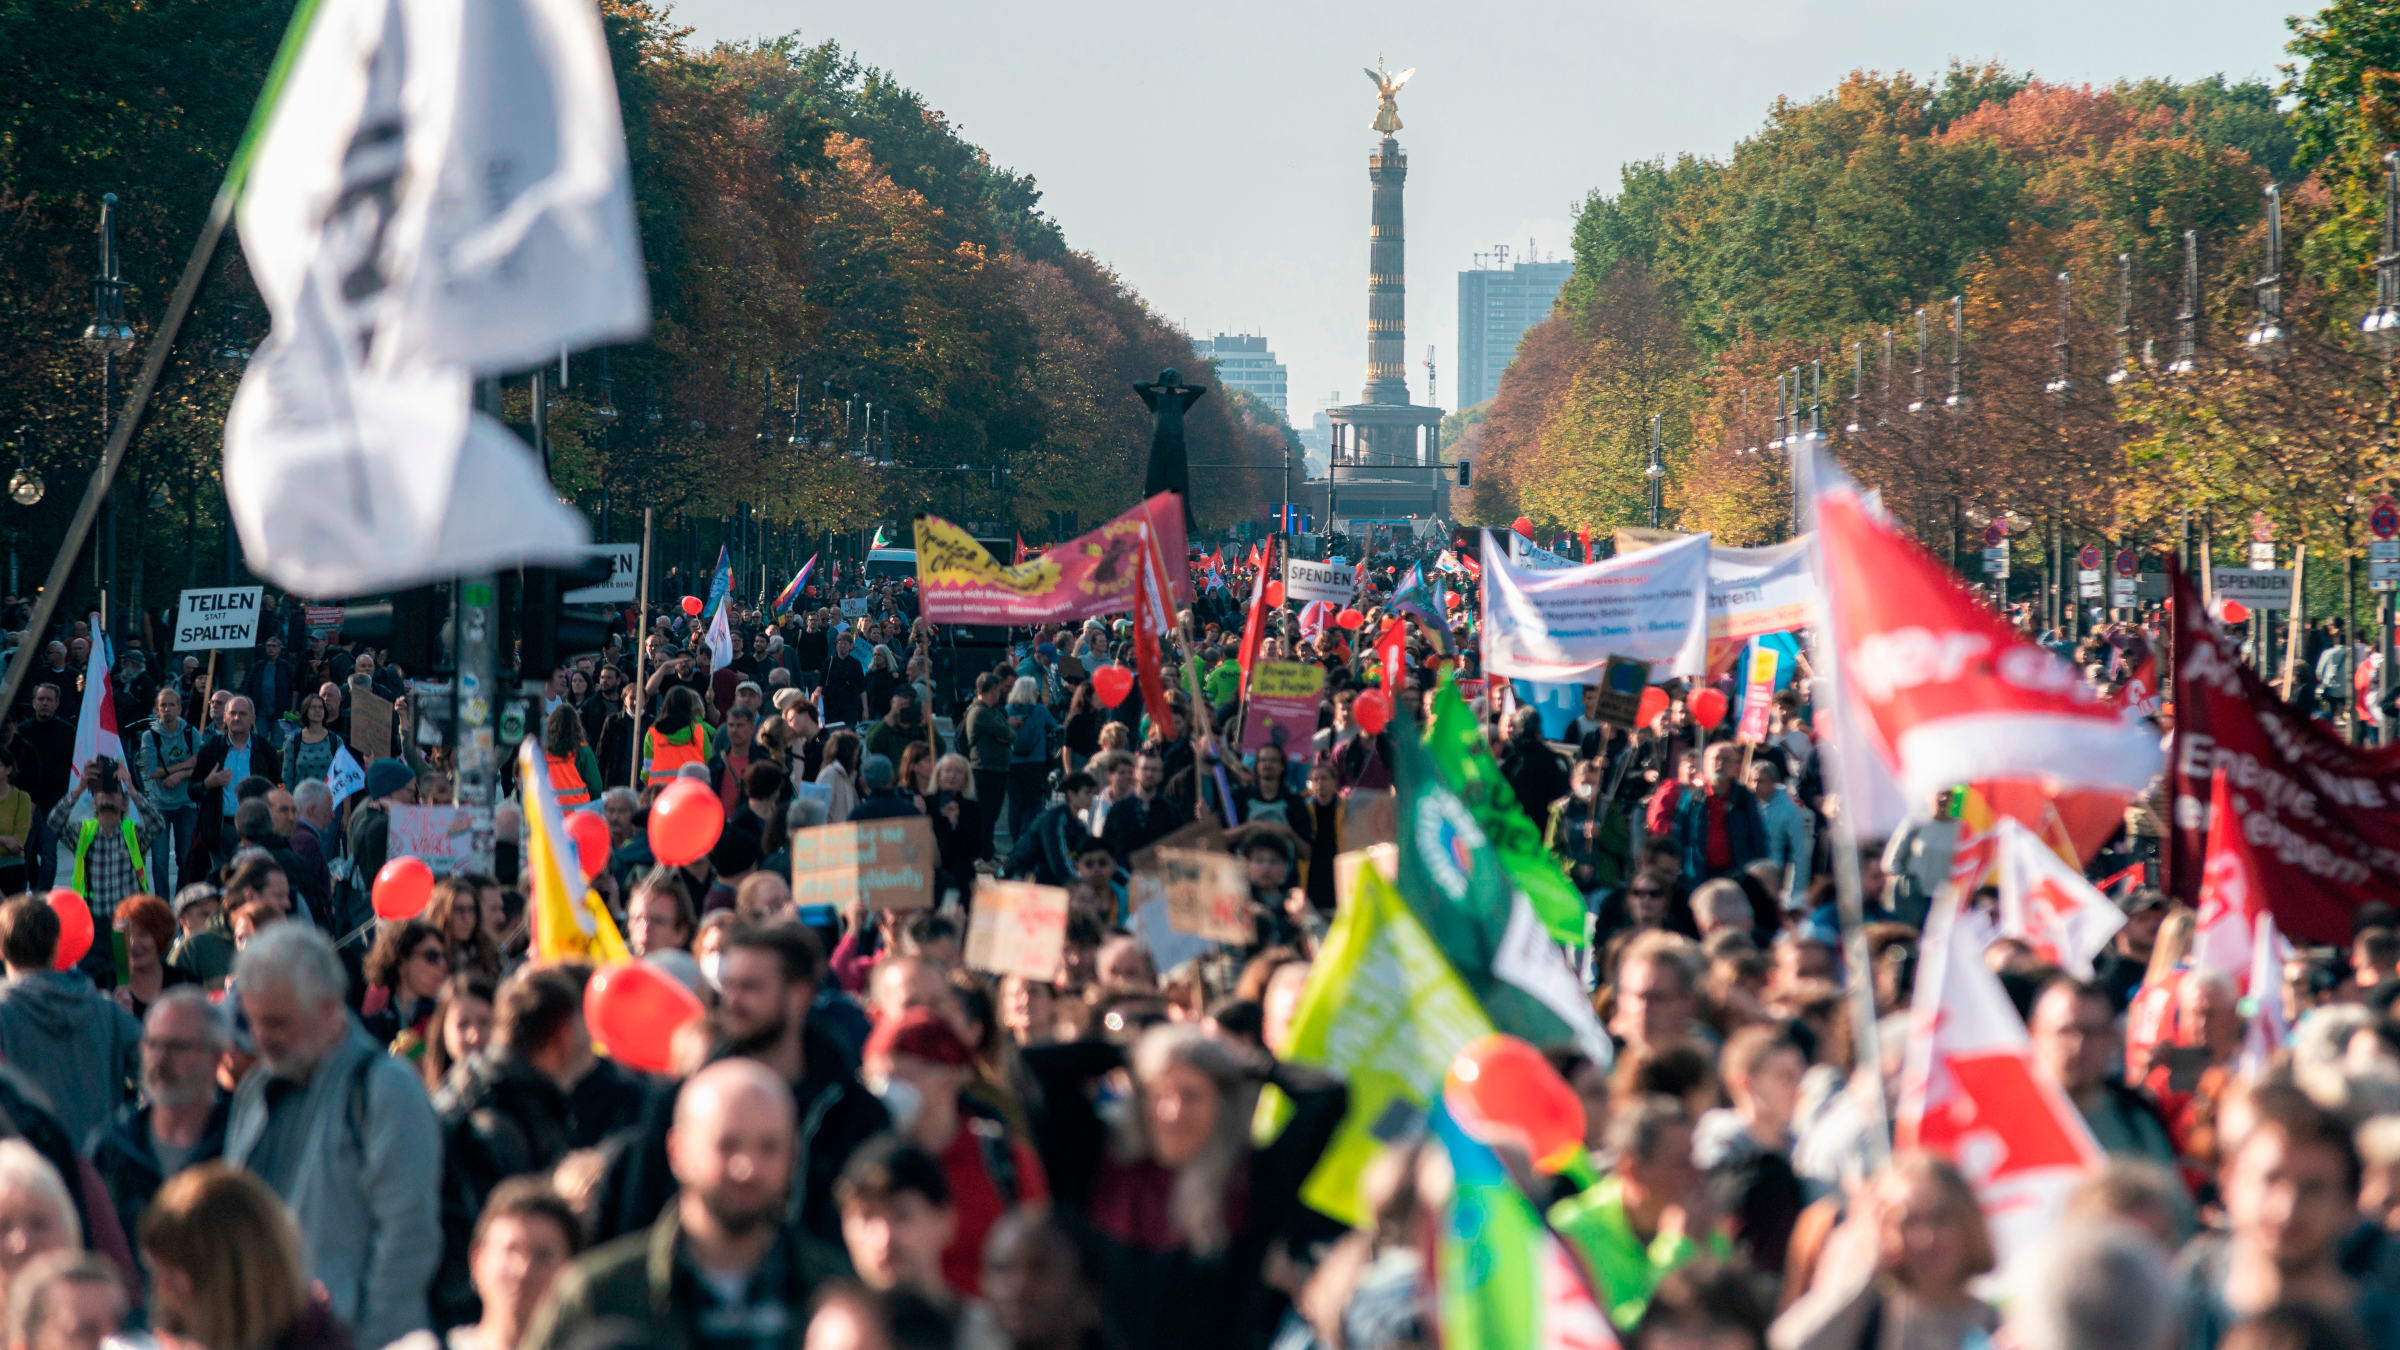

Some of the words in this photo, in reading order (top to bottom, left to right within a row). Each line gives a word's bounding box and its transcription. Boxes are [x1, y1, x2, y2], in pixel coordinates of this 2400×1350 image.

[1290, 566, 1351, 586] SPENDEN
[188, 592, 254, 612] TEILEN
[204, 612, 226, 621] STATT
[181, 623, 250, 643] SPALTEN
